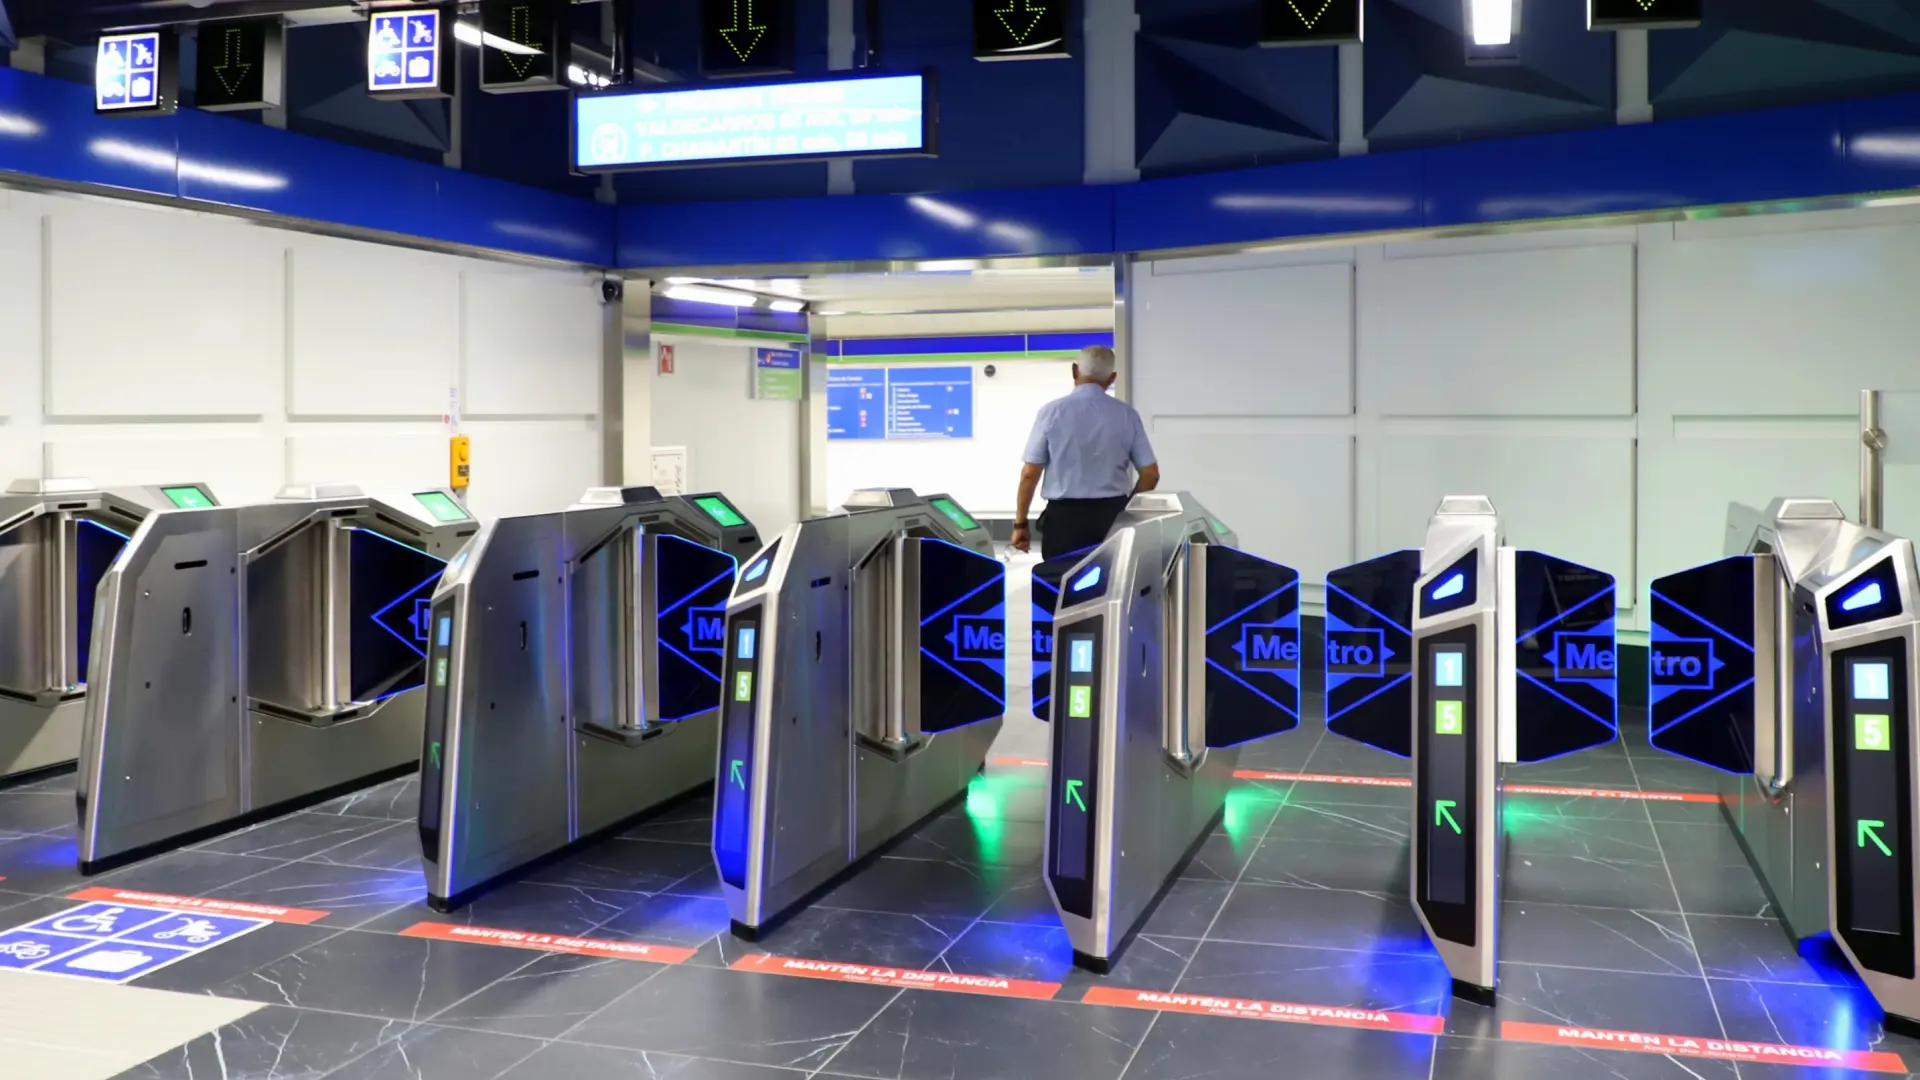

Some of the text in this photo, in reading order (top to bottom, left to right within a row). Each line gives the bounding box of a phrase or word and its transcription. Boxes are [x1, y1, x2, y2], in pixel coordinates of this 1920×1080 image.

[698, 616, 725, 640] M
[1253, 634, 1299, 660] Me
[1327, 640, 1373, 665] tro
[1566, 643, 1615, 669] Me
[1443, 658, 1454, 682] 1
[1652, 651, 1702, 676] tro
[739, 674, 749, 698] 5
[1074, 689, 1086, 714] 5
[1442, 704, 1457, 731] 5
[1863, 718, 1883, 747] 5
[526, 935, 552, 944] LA
[553, 938, 649, 955] DISTANCIA
[871, 968, 897, 979] LA
[902, 971, 1009, 989] DISTANCIA
[1235, 1001, 1263, 1012] LA
[1270, 1003, 1391, 1023] DISTANCIA
[1667, 1037, 1700, 1049] LA
[1706, 1040, 1845, 1061] DISTANCIA
